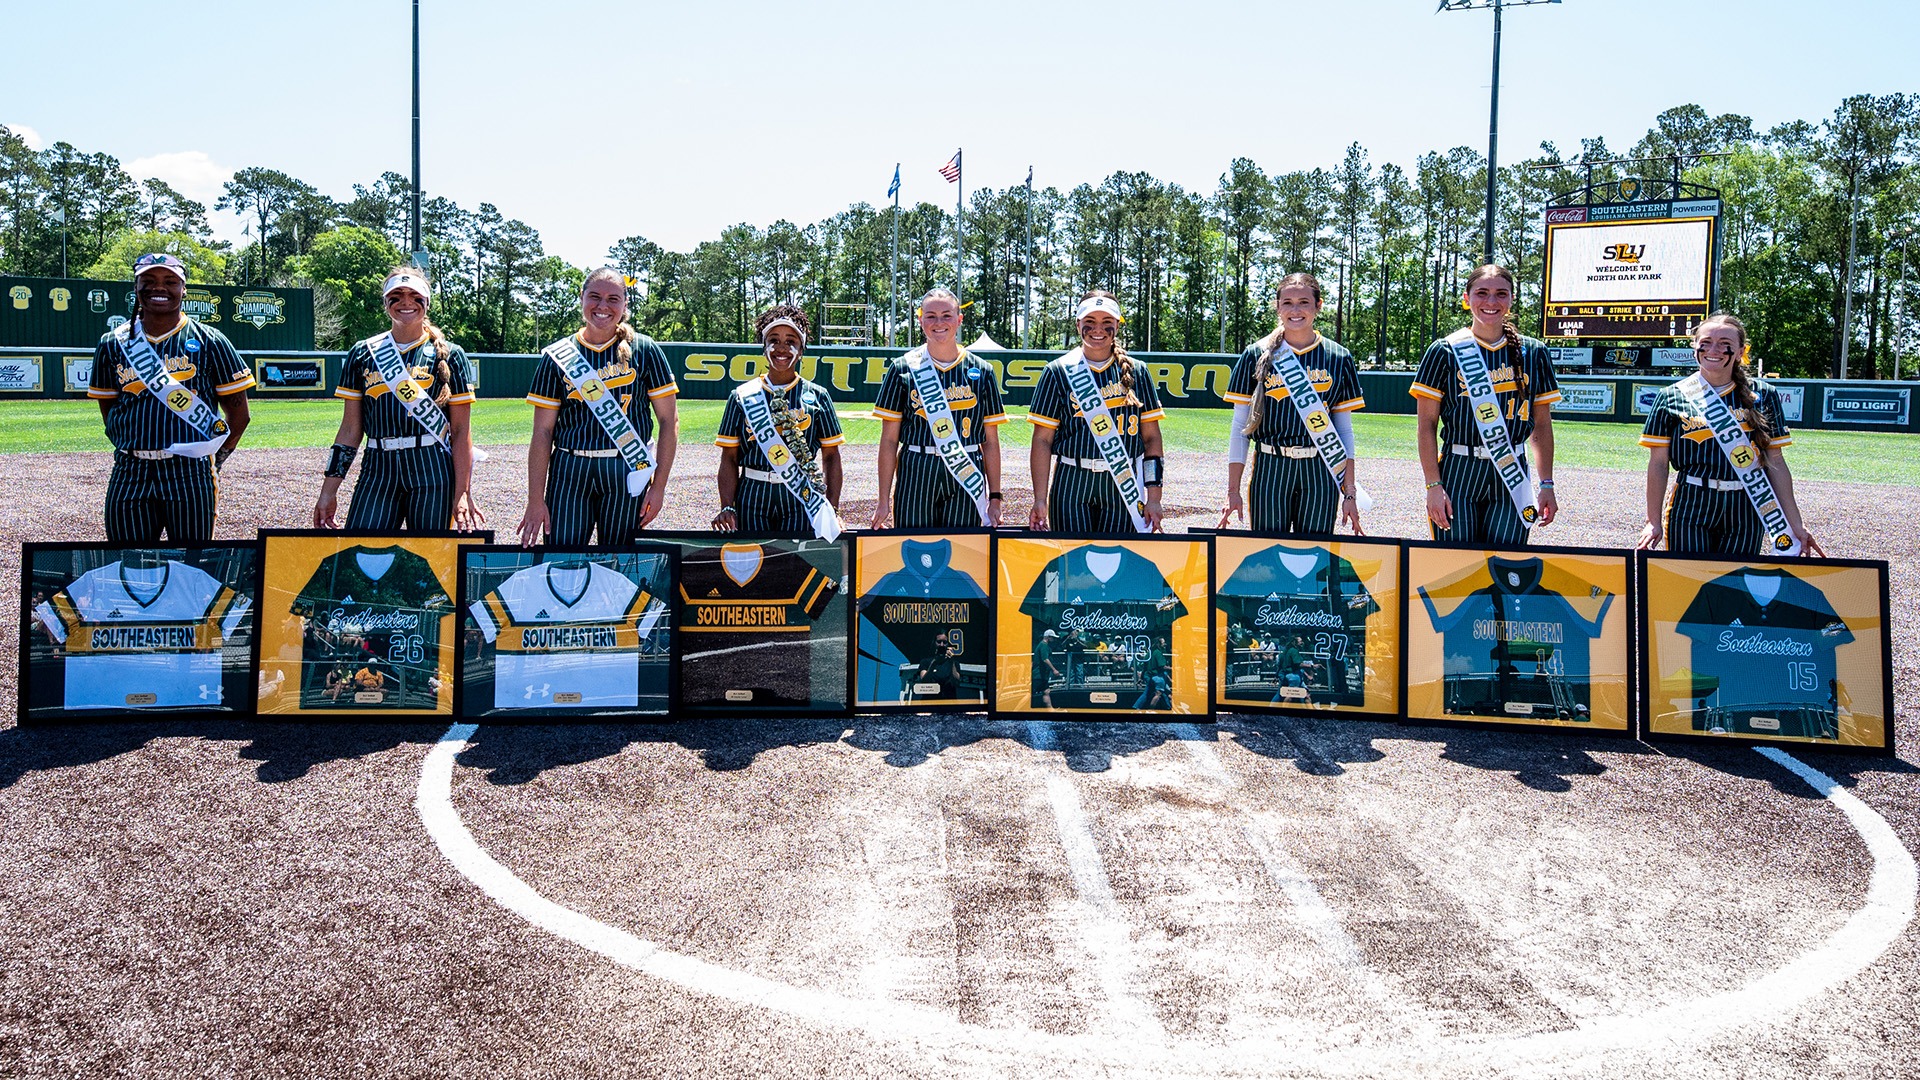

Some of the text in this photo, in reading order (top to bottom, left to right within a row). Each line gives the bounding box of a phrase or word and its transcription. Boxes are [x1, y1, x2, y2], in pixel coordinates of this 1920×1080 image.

[1591, 204, 1667, 215] SOUTHEASTERN
[1673, 204, 1716, 213] POWERADE
[1603, 244, 1646, 260] SLU
[1596, 265, 1638, 273] WELCOME
[15, 291, 27, 300] 20
[57, 293, 63, 302] 6
[181, 300, 215, 314] AMPIONS
[238, 302, 280, 315] CHAMPIONS
[1609, 306, 1632, 314] STRIKE
[1646, 306, 1660, 314] OUT
[369, 335, 404, 382] LIONS
[399, 383, 415, 400] 26
[551, 342, 590, 379] IONS
[1605, 349, 1639, 365] SLU
[124, 337, 169, 393] LIONS
[171, 393, 188, 409] 30
[1455, 343, 1492, 398] LIONS
[1480, 407, 1495, 420] 14
[913, 364, 947, 414] LIONS
[1065, 359, 1102, 413] LIONS
[1095, 418, 1109, 432] 13
[1275, 354, 1318, 409] LIONS
[1309, 414, 1326, 429] 27
[1780, 393, 1791, 403] YA
[620, 393, 632, 415] 7
[1505, 398, 1530, 421] 14
[1862, 402, 1896, 410] LIGHT
[742, 391, 776, 444] LIONS
[773, 449, 784, 460] 4
[962, 417, 971, 438] 9
[1116, 413, 1139, 436] 13
[1696, 389, 1743, 445] LIONS
[1734, 449, 1751, 464] 15
[328, 606, 419, 630] Southeastern
[697, 606, 786, 625] SOUTHEASTERN
[883, 603, 970, 624] SOUTHEASTERN
[1059, 608, 1148, 630] Southeastern
[1254, 604, 1343, 628] Southeastern
[91, 626, 196, 650] SOUTHEASTERN
[522, 626, 618, 649] SOUTHEASTERN
[948, 628, 965, 656] 9
[1473, 618, 1564, 644] SOUTHEASTERN
[388, 634, 424, 664] 26
[1124, 635, 1152, 662] 13
[1314, 631, 1349, 661] 27
[1717, 630, 1813, 657] Southeastern
[1535, 648, 1565, 677] 14
[1788, 661, 1819, 692] 15
